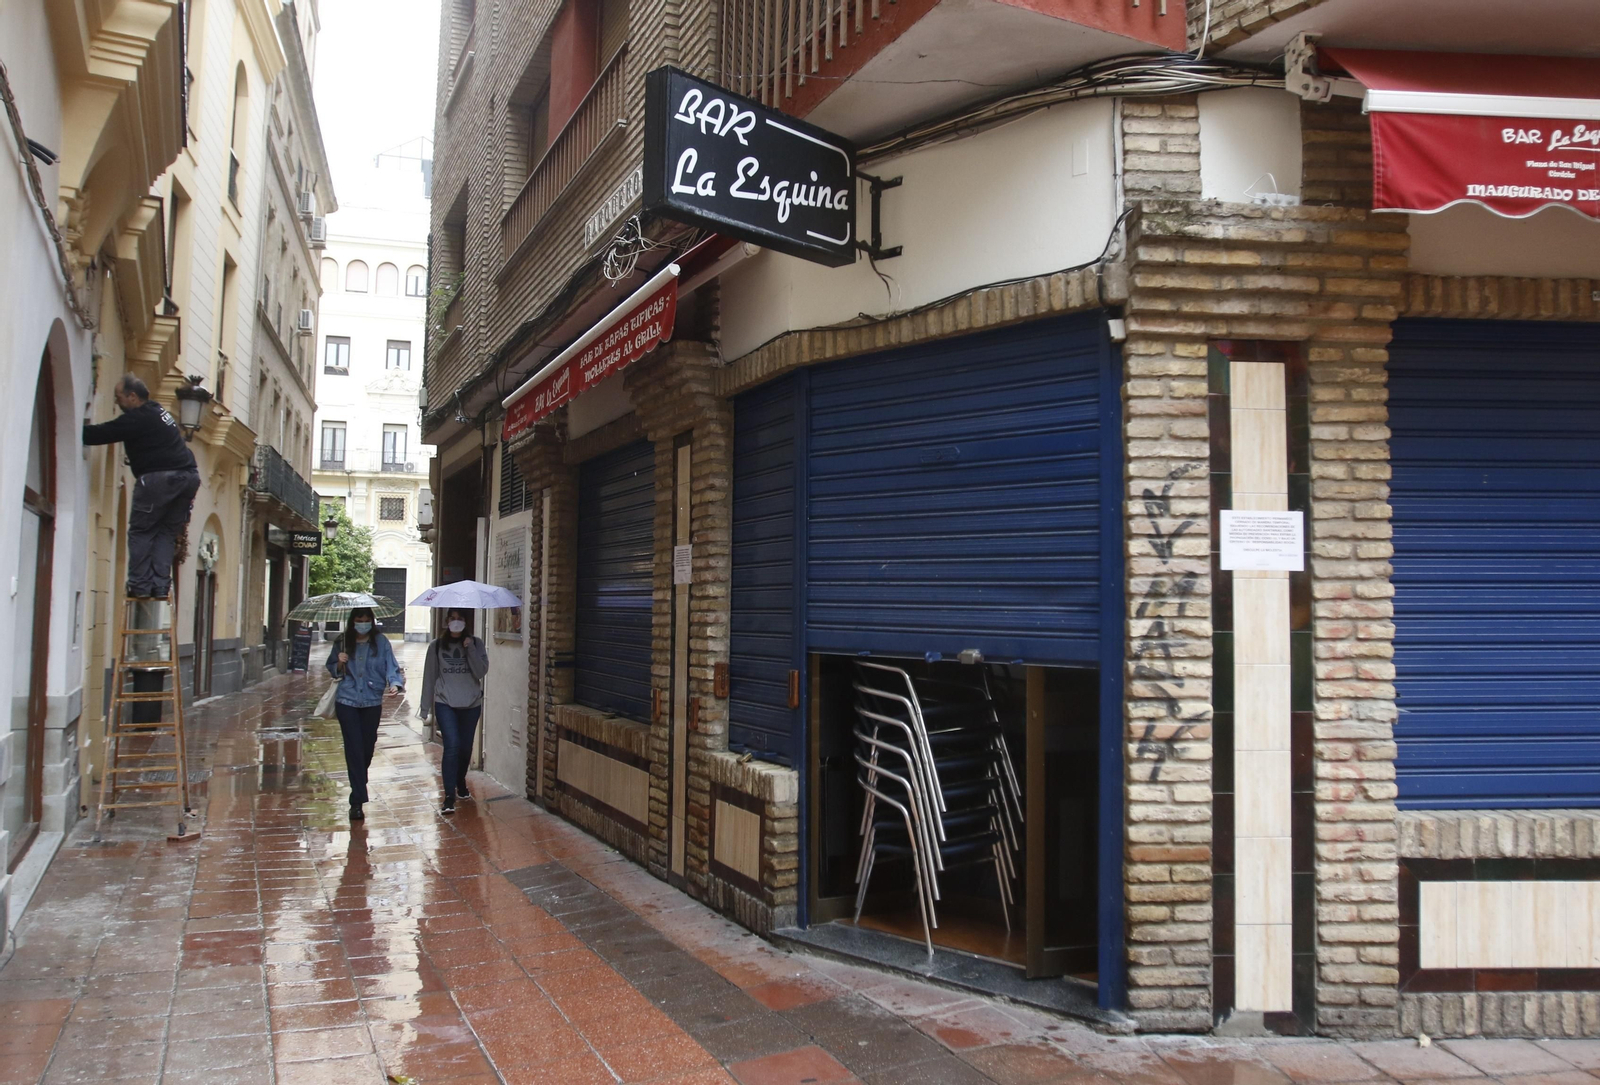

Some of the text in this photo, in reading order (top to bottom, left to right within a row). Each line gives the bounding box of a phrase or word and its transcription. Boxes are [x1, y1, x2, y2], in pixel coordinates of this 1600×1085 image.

[674, 88, 757, 146] BAR
[1502, 124, 1600, 152] BAR La Esq
[1526, 160, 1595, 170] Plaza de San Miguel
[671, 147, 849, 224] La Esquina
[1466, 184, 1600, 201] INAUGURADO DE
[585, 321, 662, 382] MOLLETES AL GRILL
[292, 541, 318, 549] COVAP
[442, 666, 471, 674] adidas
